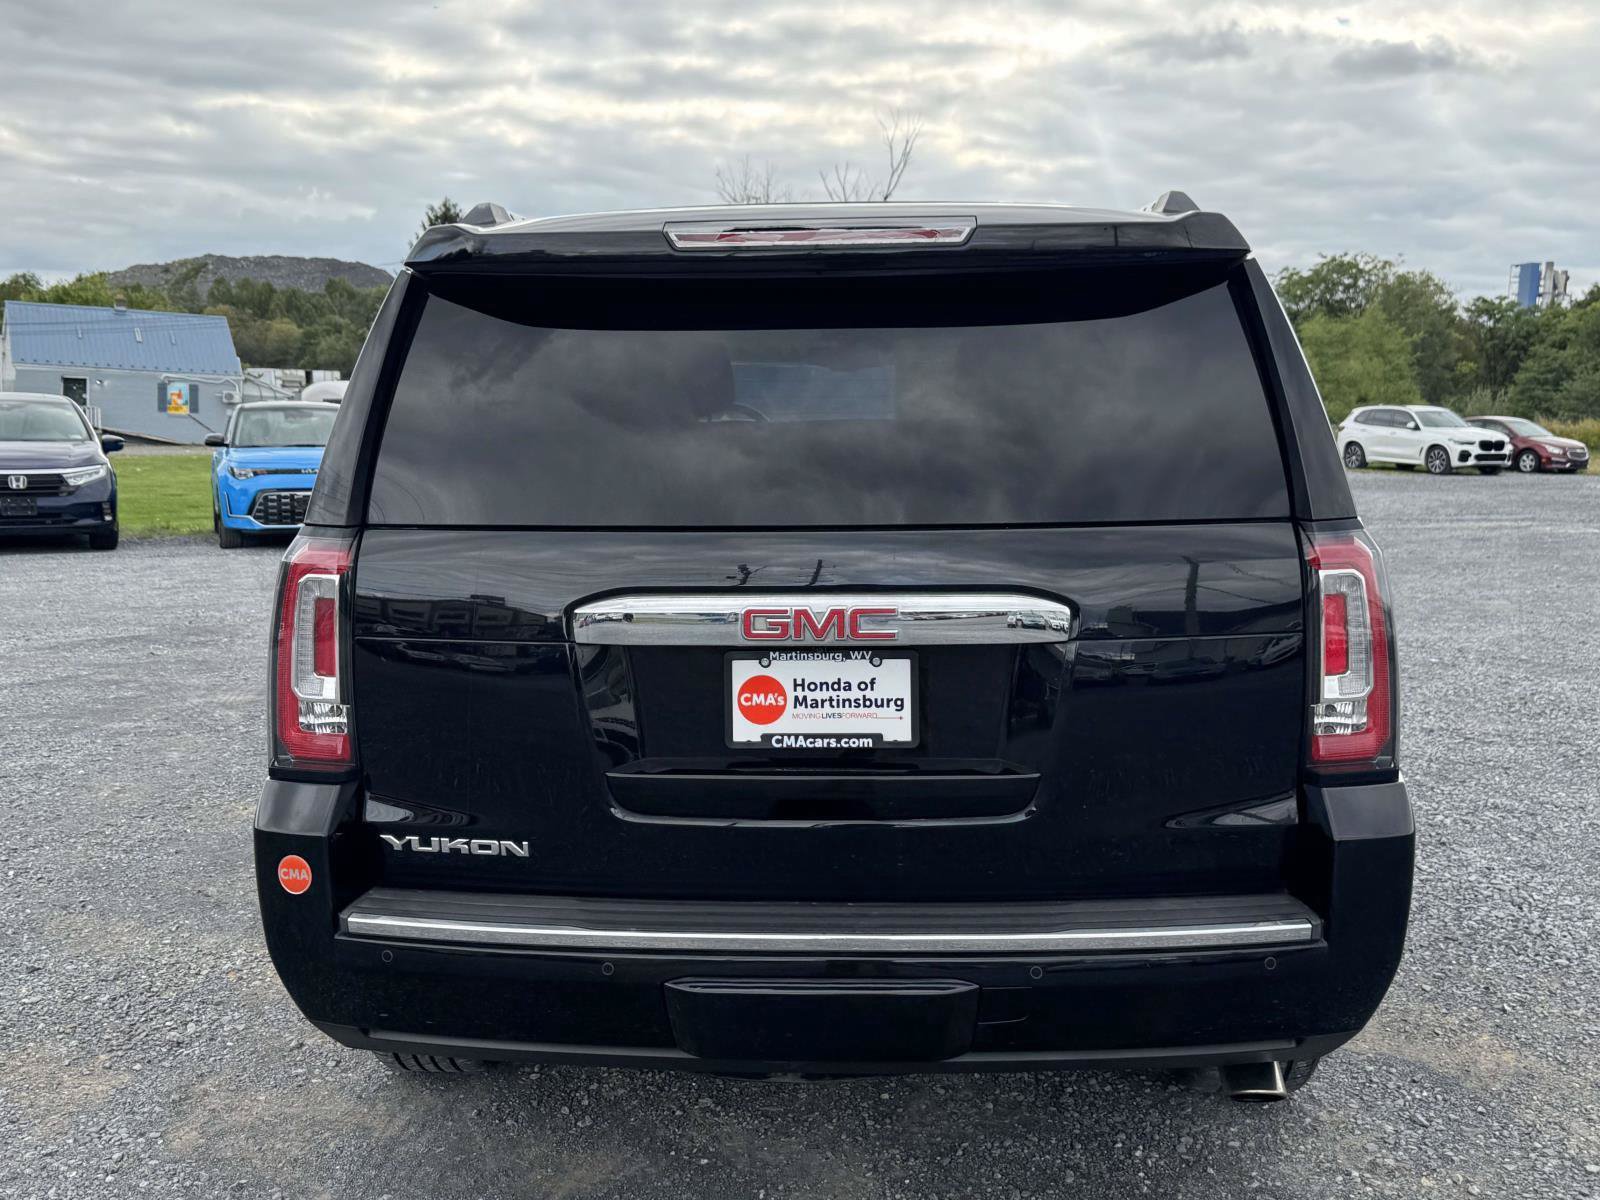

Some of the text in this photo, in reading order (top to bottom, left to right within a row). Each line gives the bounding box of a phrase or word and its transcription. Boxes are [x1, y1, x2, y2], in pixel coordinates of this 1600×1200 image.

[742, 606, 898, 641] GMC
[769, 651, 872, 662] Martinsburg, WV
[793, 678, 876, 692] Honda of
[740, 692, 785, 706] CMA's
[793, 695, 904, 711] Martinsburg
[771, 735, 873, 748] CMAcars.com
[380, 834, 530, 857] YUKON
[280, 867, 309, 881] CMA
